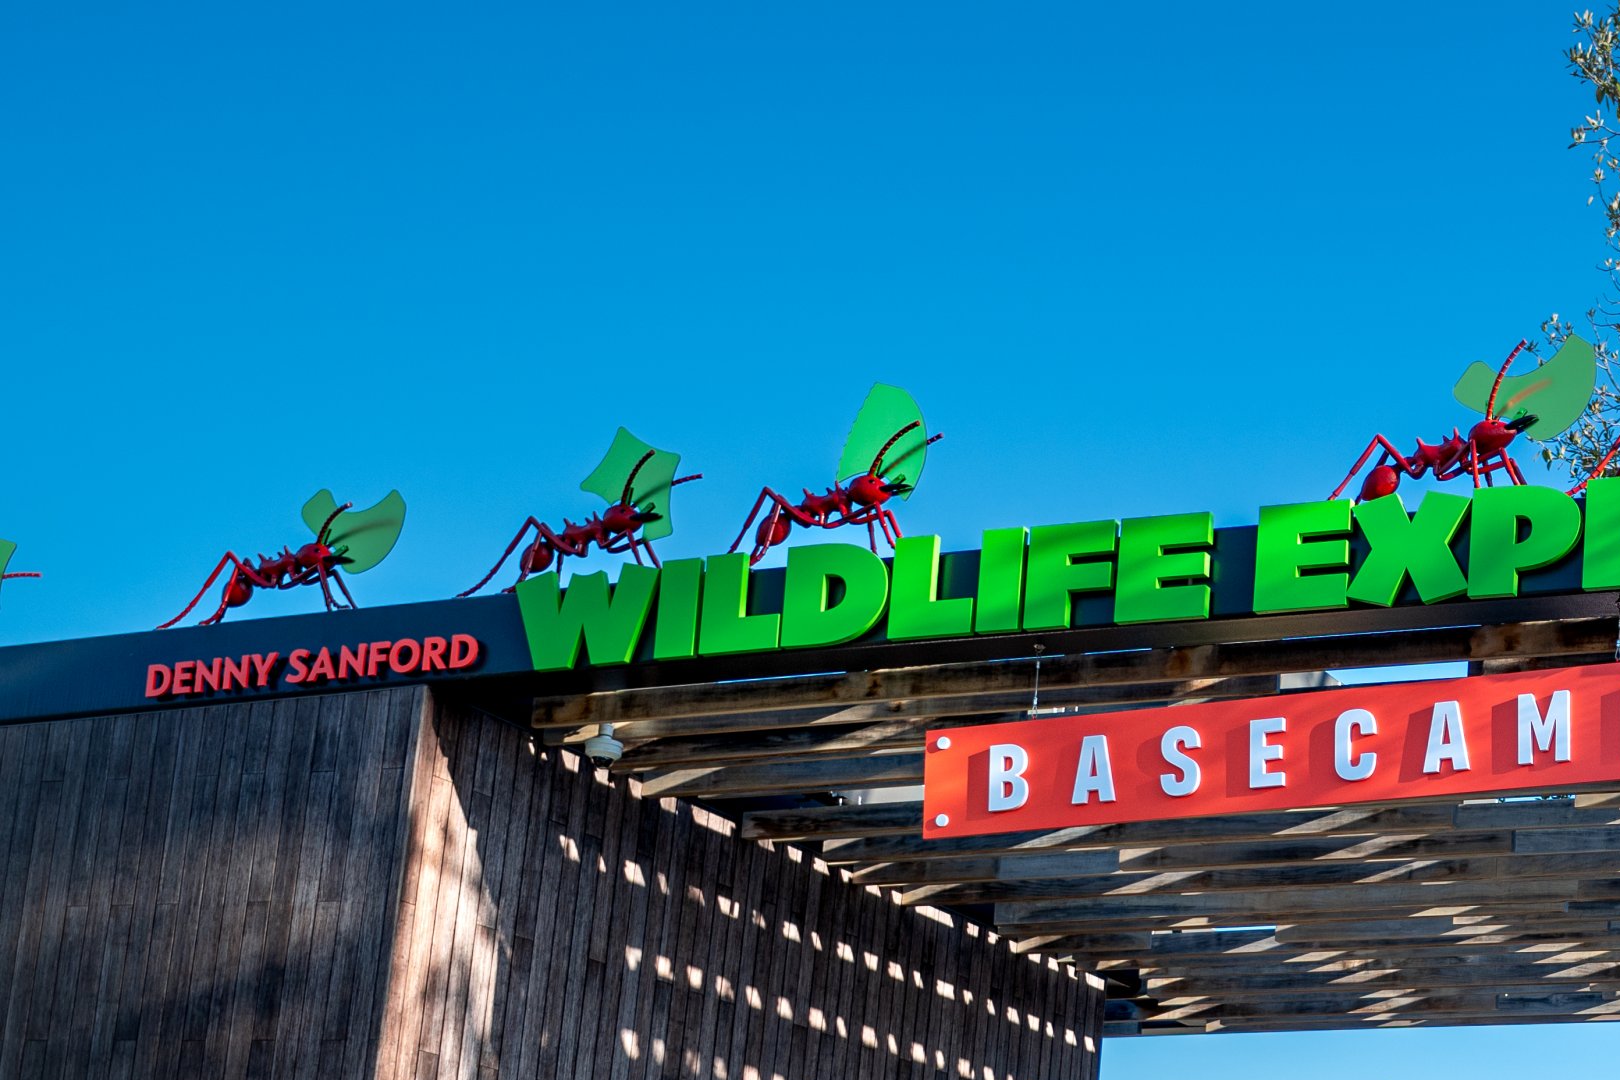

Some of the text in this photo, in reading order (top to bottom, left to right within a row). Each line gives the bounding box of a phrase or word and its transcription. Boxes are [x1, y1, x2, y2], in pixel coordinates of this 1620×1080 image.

[515, 511, 1216, 671] WILDLIFE
[145, 633, 479, 697] DENNY SANFORD
